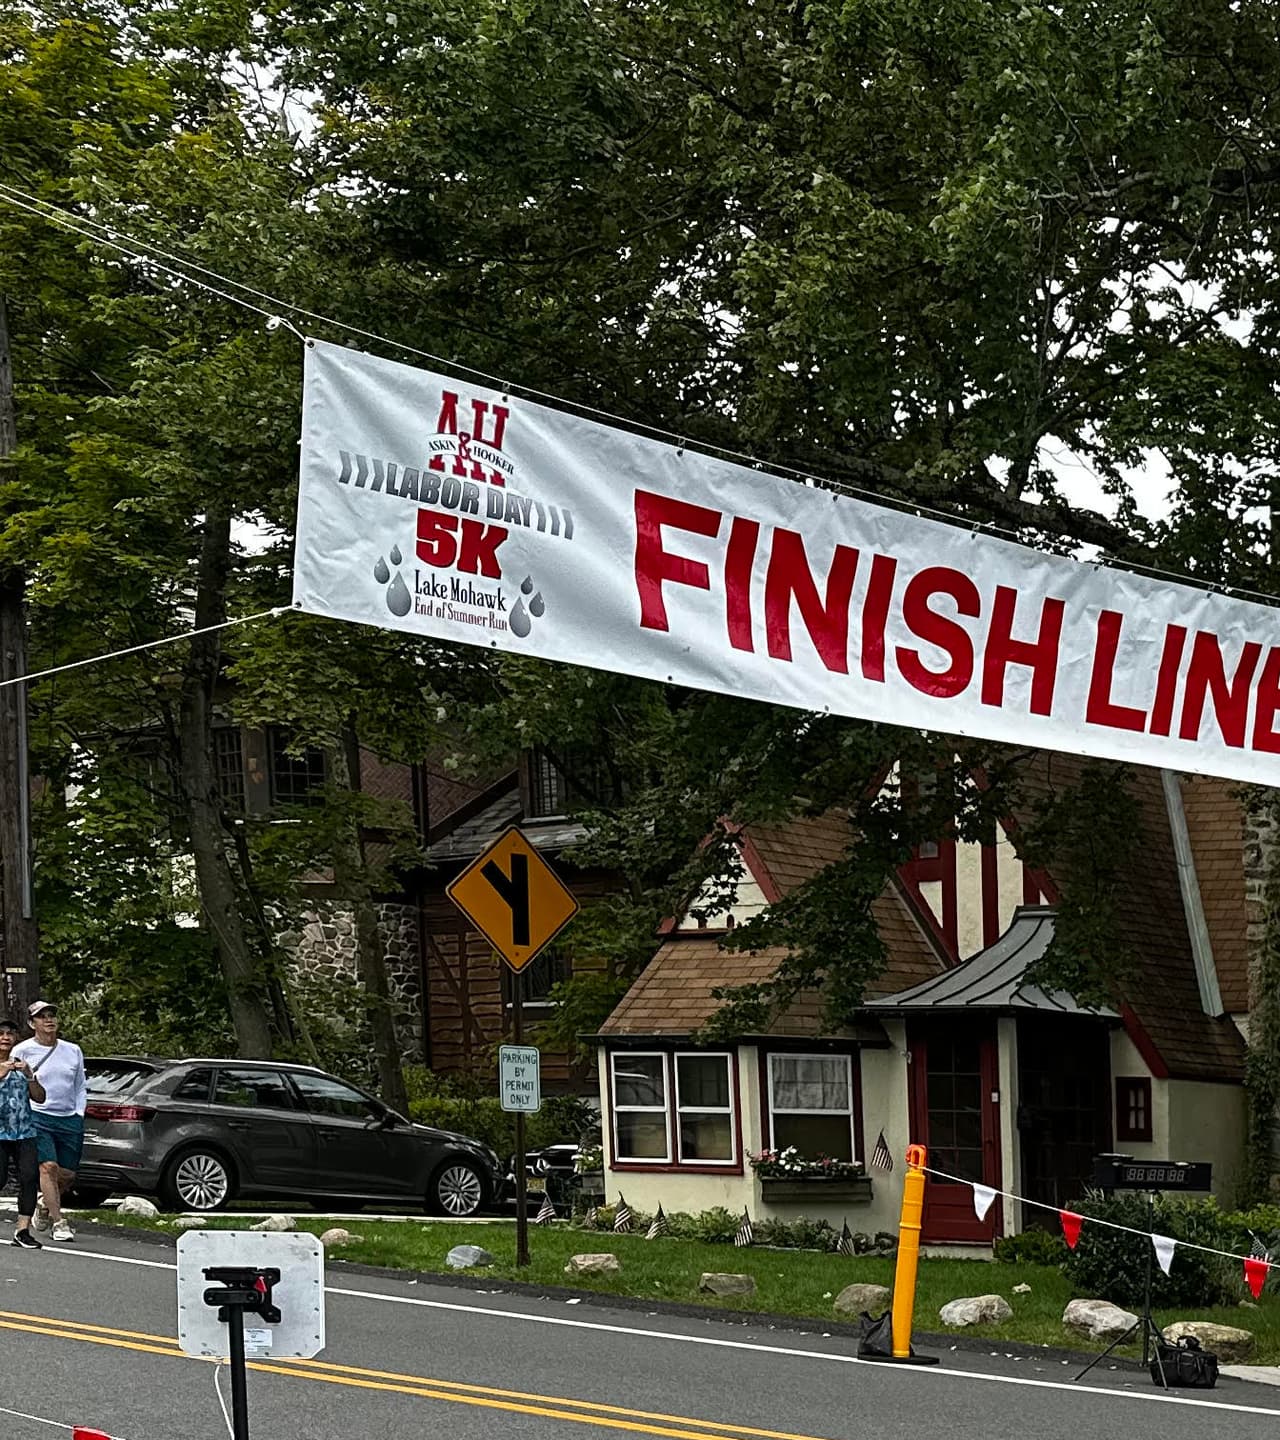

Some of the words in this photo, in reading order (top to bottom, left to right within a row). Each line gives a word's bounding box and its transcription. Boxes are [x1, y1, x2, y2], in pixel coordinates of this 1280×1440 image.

[428, 439, 457, 453] ASKIN
[458, 431, 471, 461] &
[473, 445, 515, 475] HOOKER
[386, 462, 481, 516] LABOR
[486, 483, 533, 528] DAY
[416, 507, 509, 580] 5K
[414, 569, 448, 600] Lake
[450, 576, 508, 612] Mohawk
[634, 488, 1066, 717] FINISH
[414, 596, 433, 617] End
[436, 600, 448, 619] of
[447, 604, 488, 628] Summer
[489, 609, 508, 632] Run
[502, 1053, 537, 1065] PARKING
[514, 1067, 525, 1078] BY
[505, 1080, 534, 1091] PERMIT
[510, 1094, 530, 1105] ONLY
